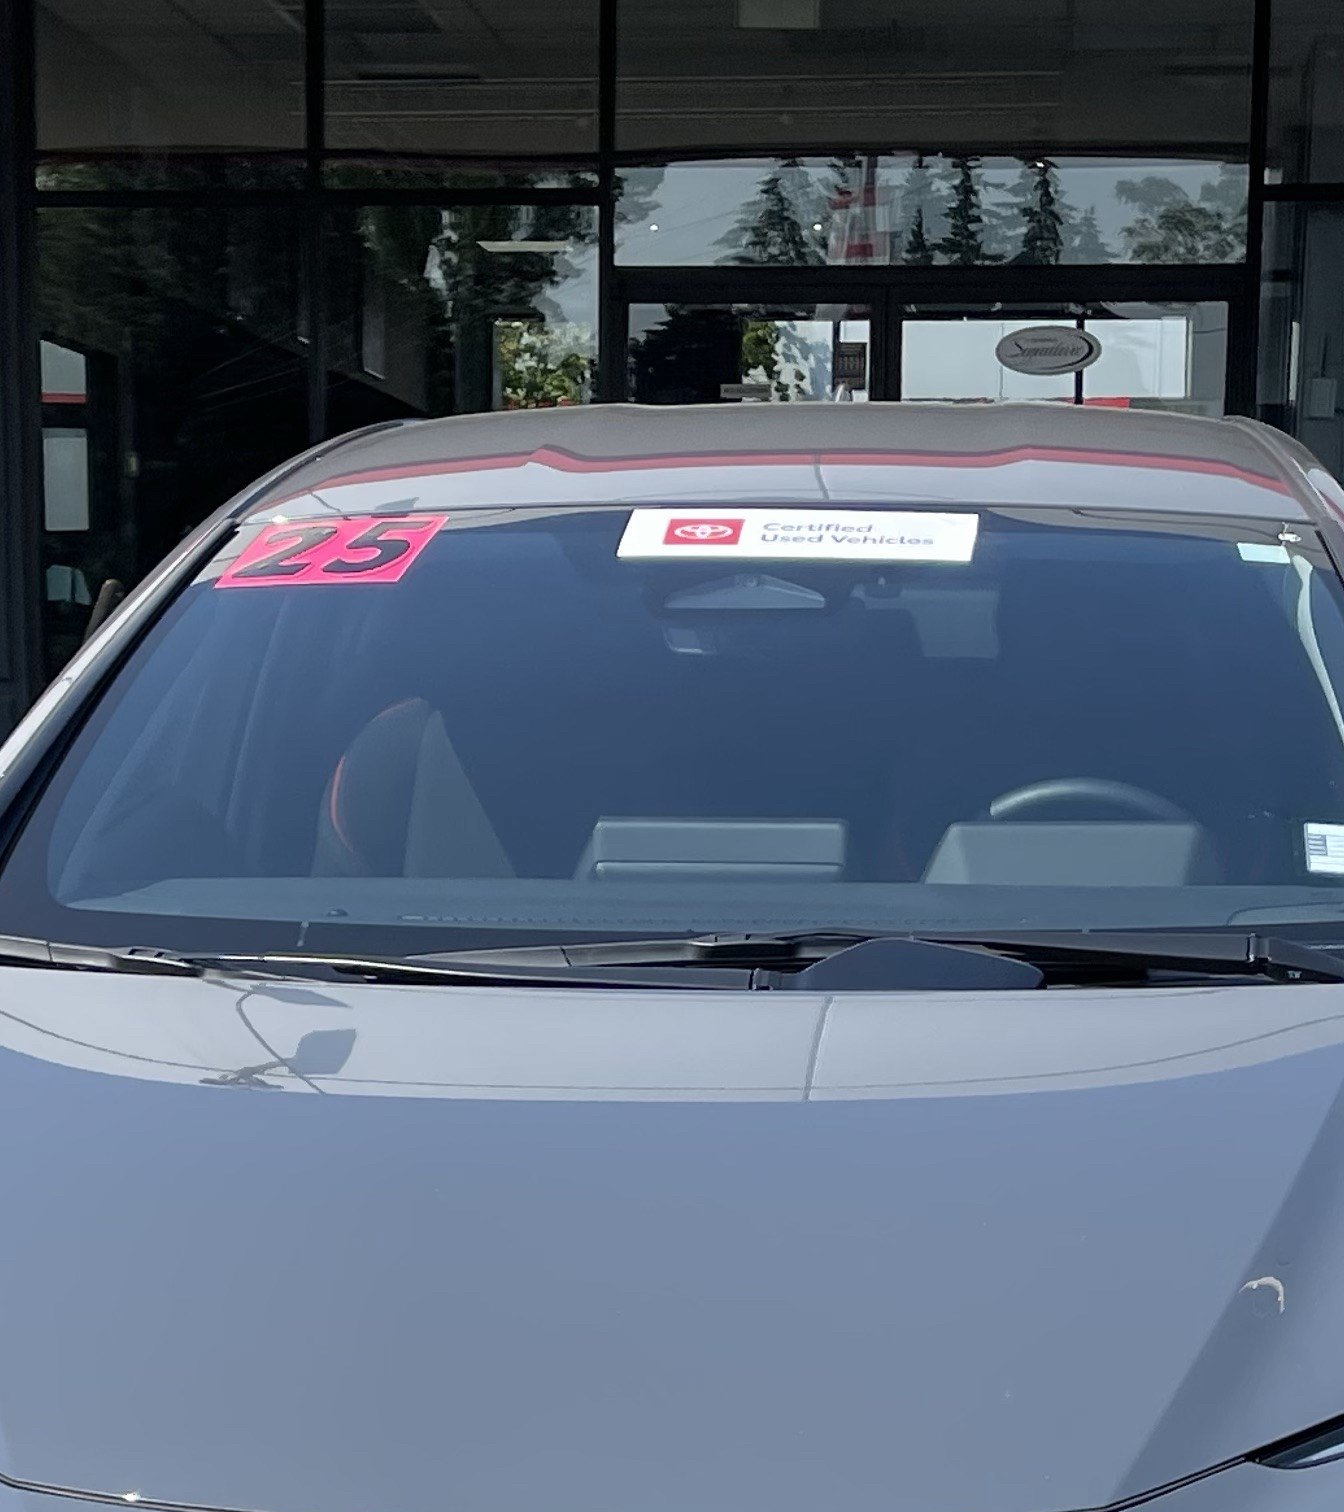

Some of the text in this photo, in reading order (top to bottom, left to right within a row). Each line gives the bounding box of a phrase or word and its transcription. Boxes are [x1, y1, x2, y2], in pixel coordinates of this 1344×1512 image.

[762, 522, 874, 533] Certified
[760, 534, 935, 546] Used Vehicles
[231, 521, 434, 579] 25
